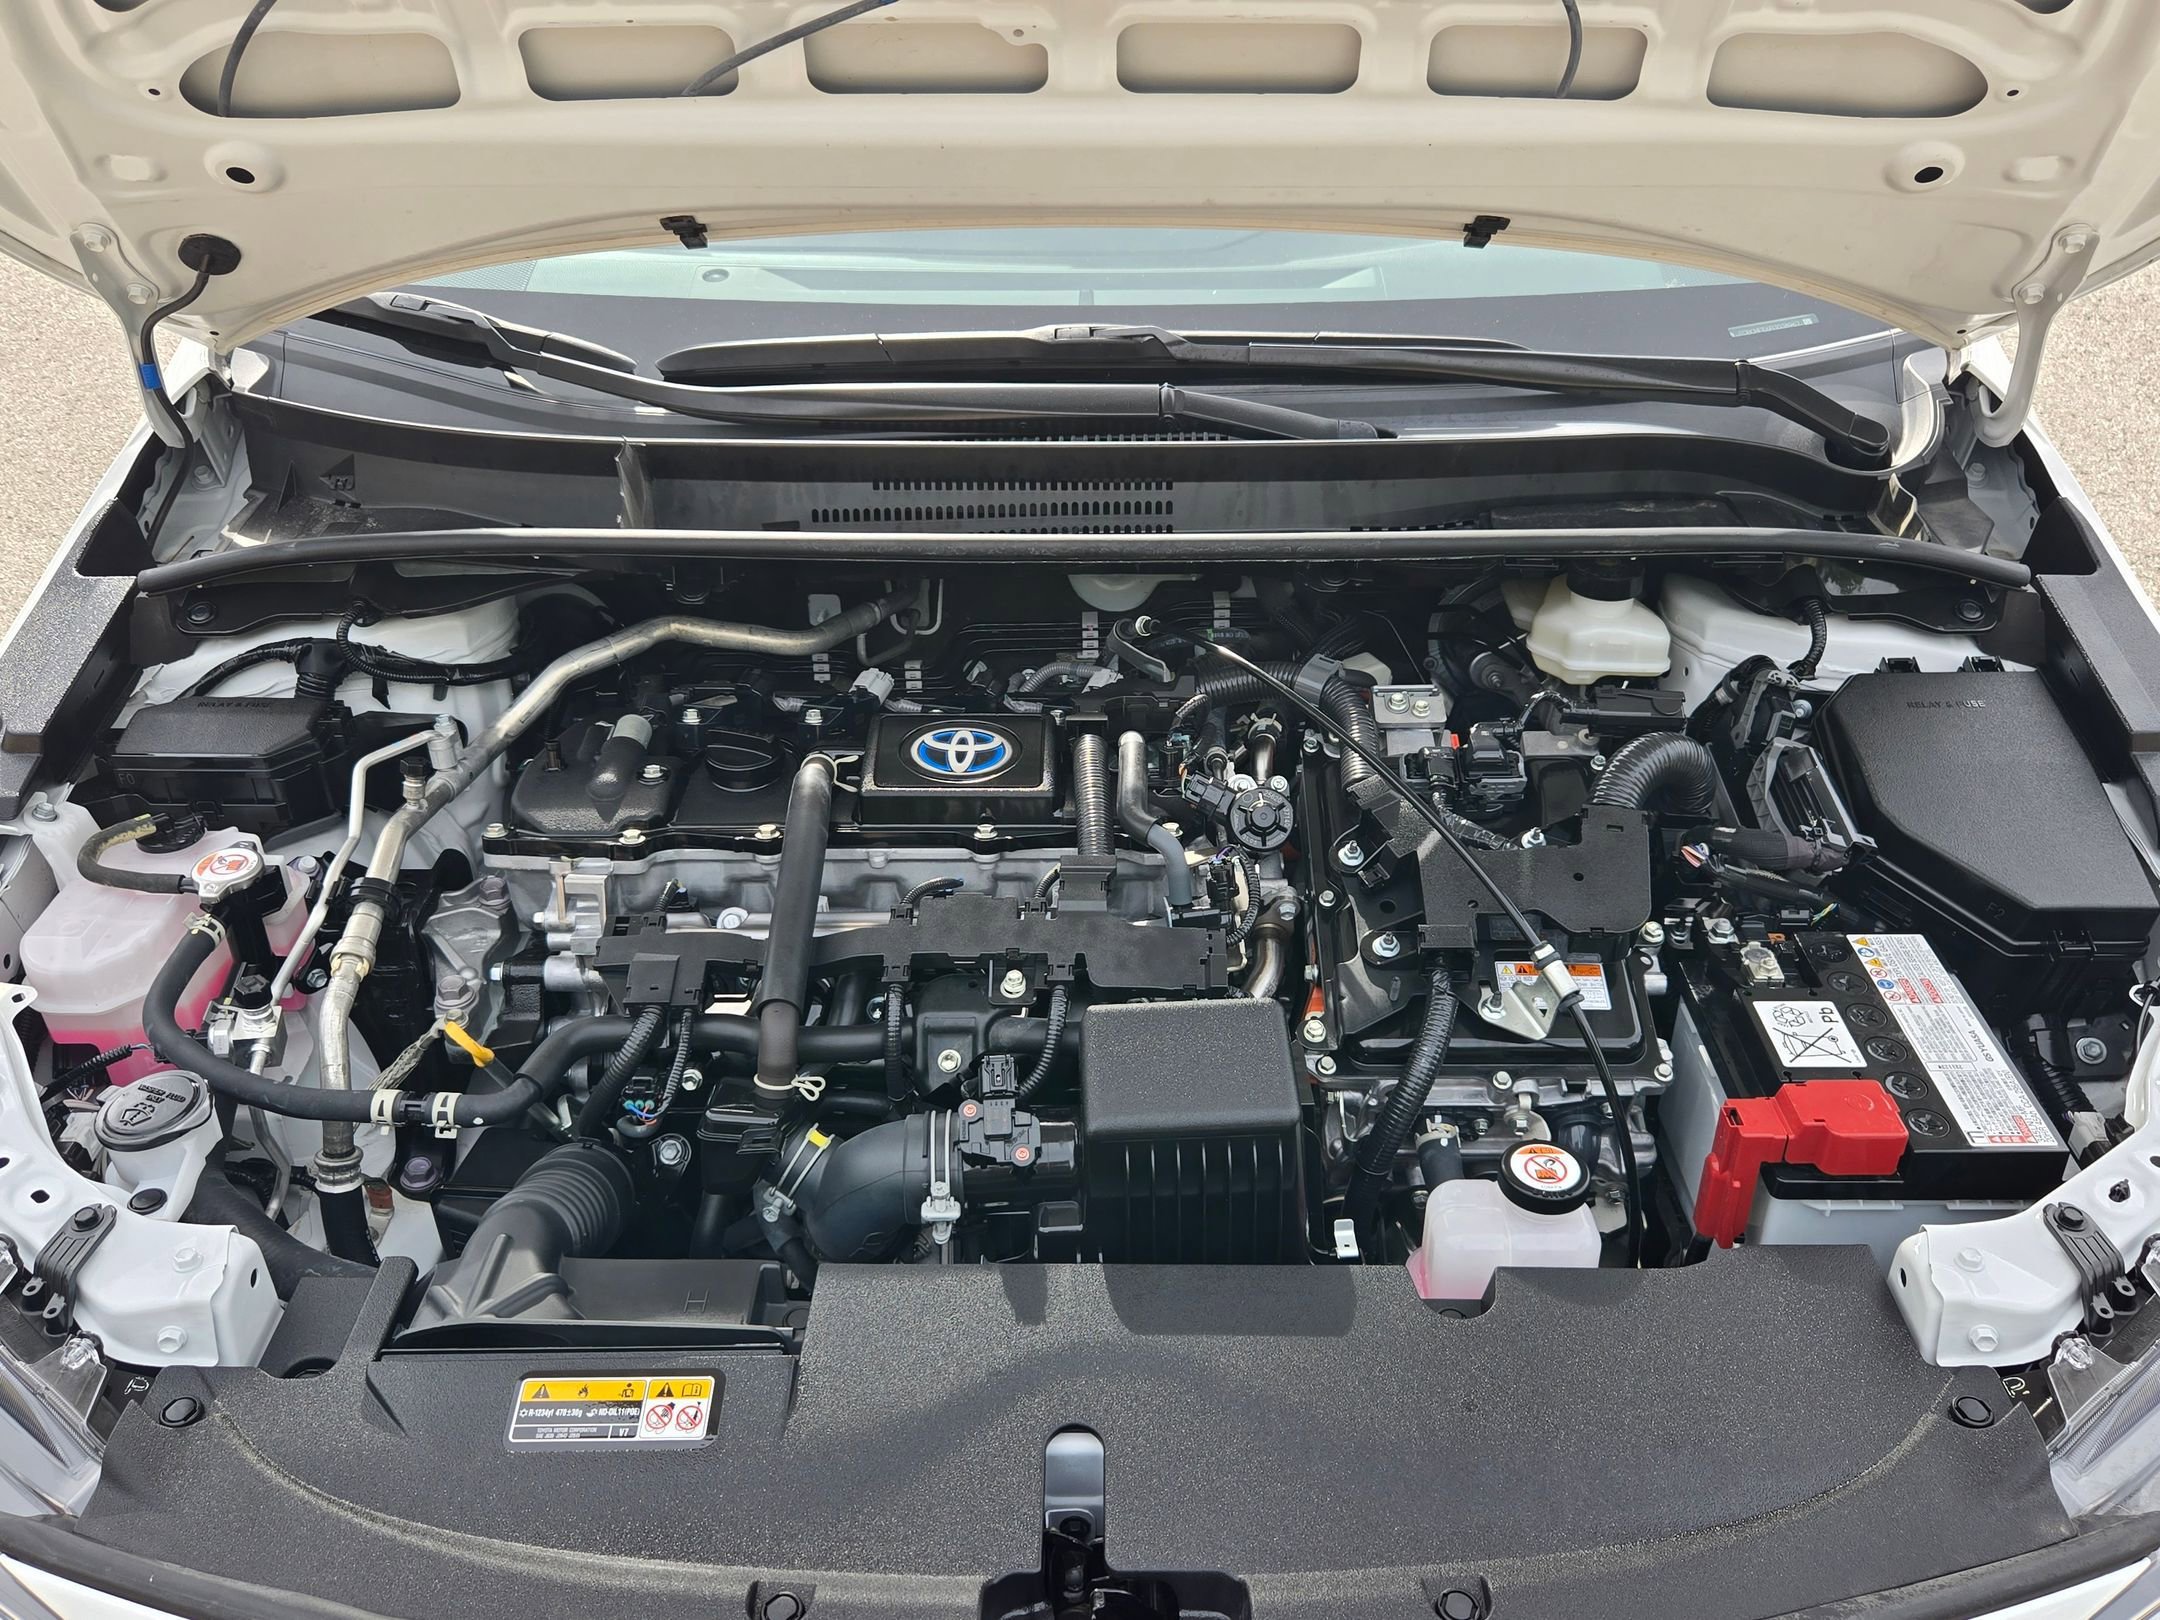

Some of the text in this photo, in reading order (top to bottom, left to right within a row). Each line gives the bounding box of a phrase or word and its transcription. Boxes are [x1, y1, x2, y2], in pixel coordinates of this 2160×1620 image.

[1906, 700, 1942, 709] RELAY
[1955, 699, 1986, 709] FUSE
[1818, 1006, 1839, 1024] Pb
[1966, 1029, 1988, 1052] YUASA
[1981, 1052, 1995, 1061] GS
[683, 1287, 710, 1313] H
[528, 1407, 554, 1418] R-1234yf
[618, 1428, 630, 1437] V7
